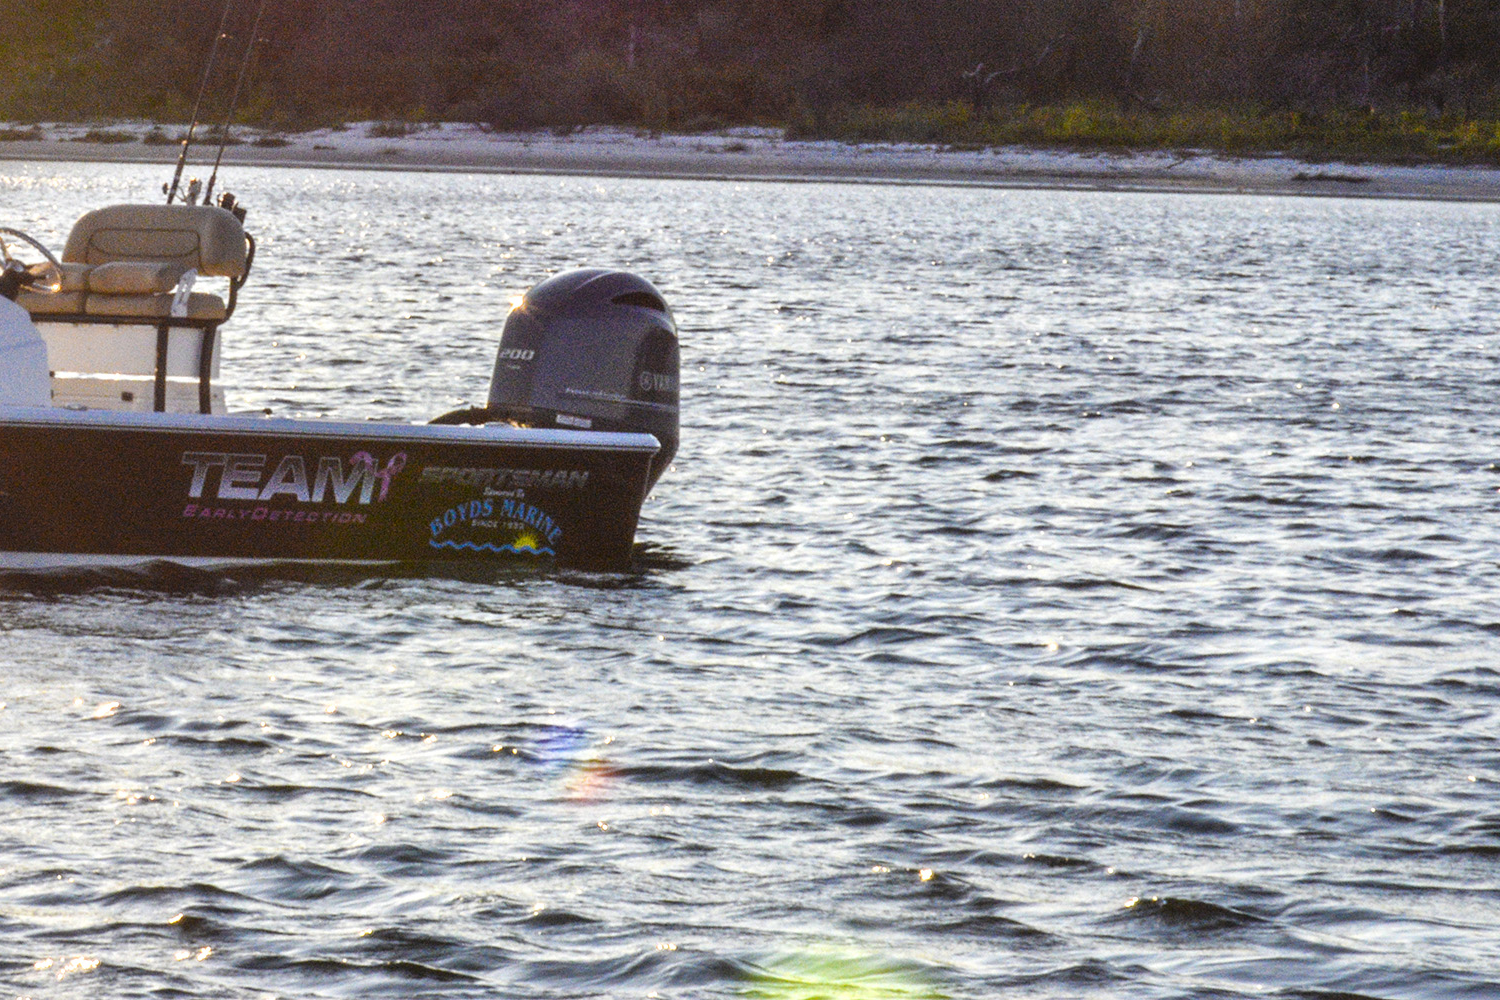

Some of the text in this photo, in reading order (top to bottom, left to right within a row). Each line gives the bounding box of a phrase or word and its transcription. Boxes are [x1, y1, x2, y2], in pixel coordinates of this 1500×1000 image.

[181, 451, 379, 505] TEAM
[430, 499, 562, 545] BOYDS MARINE
